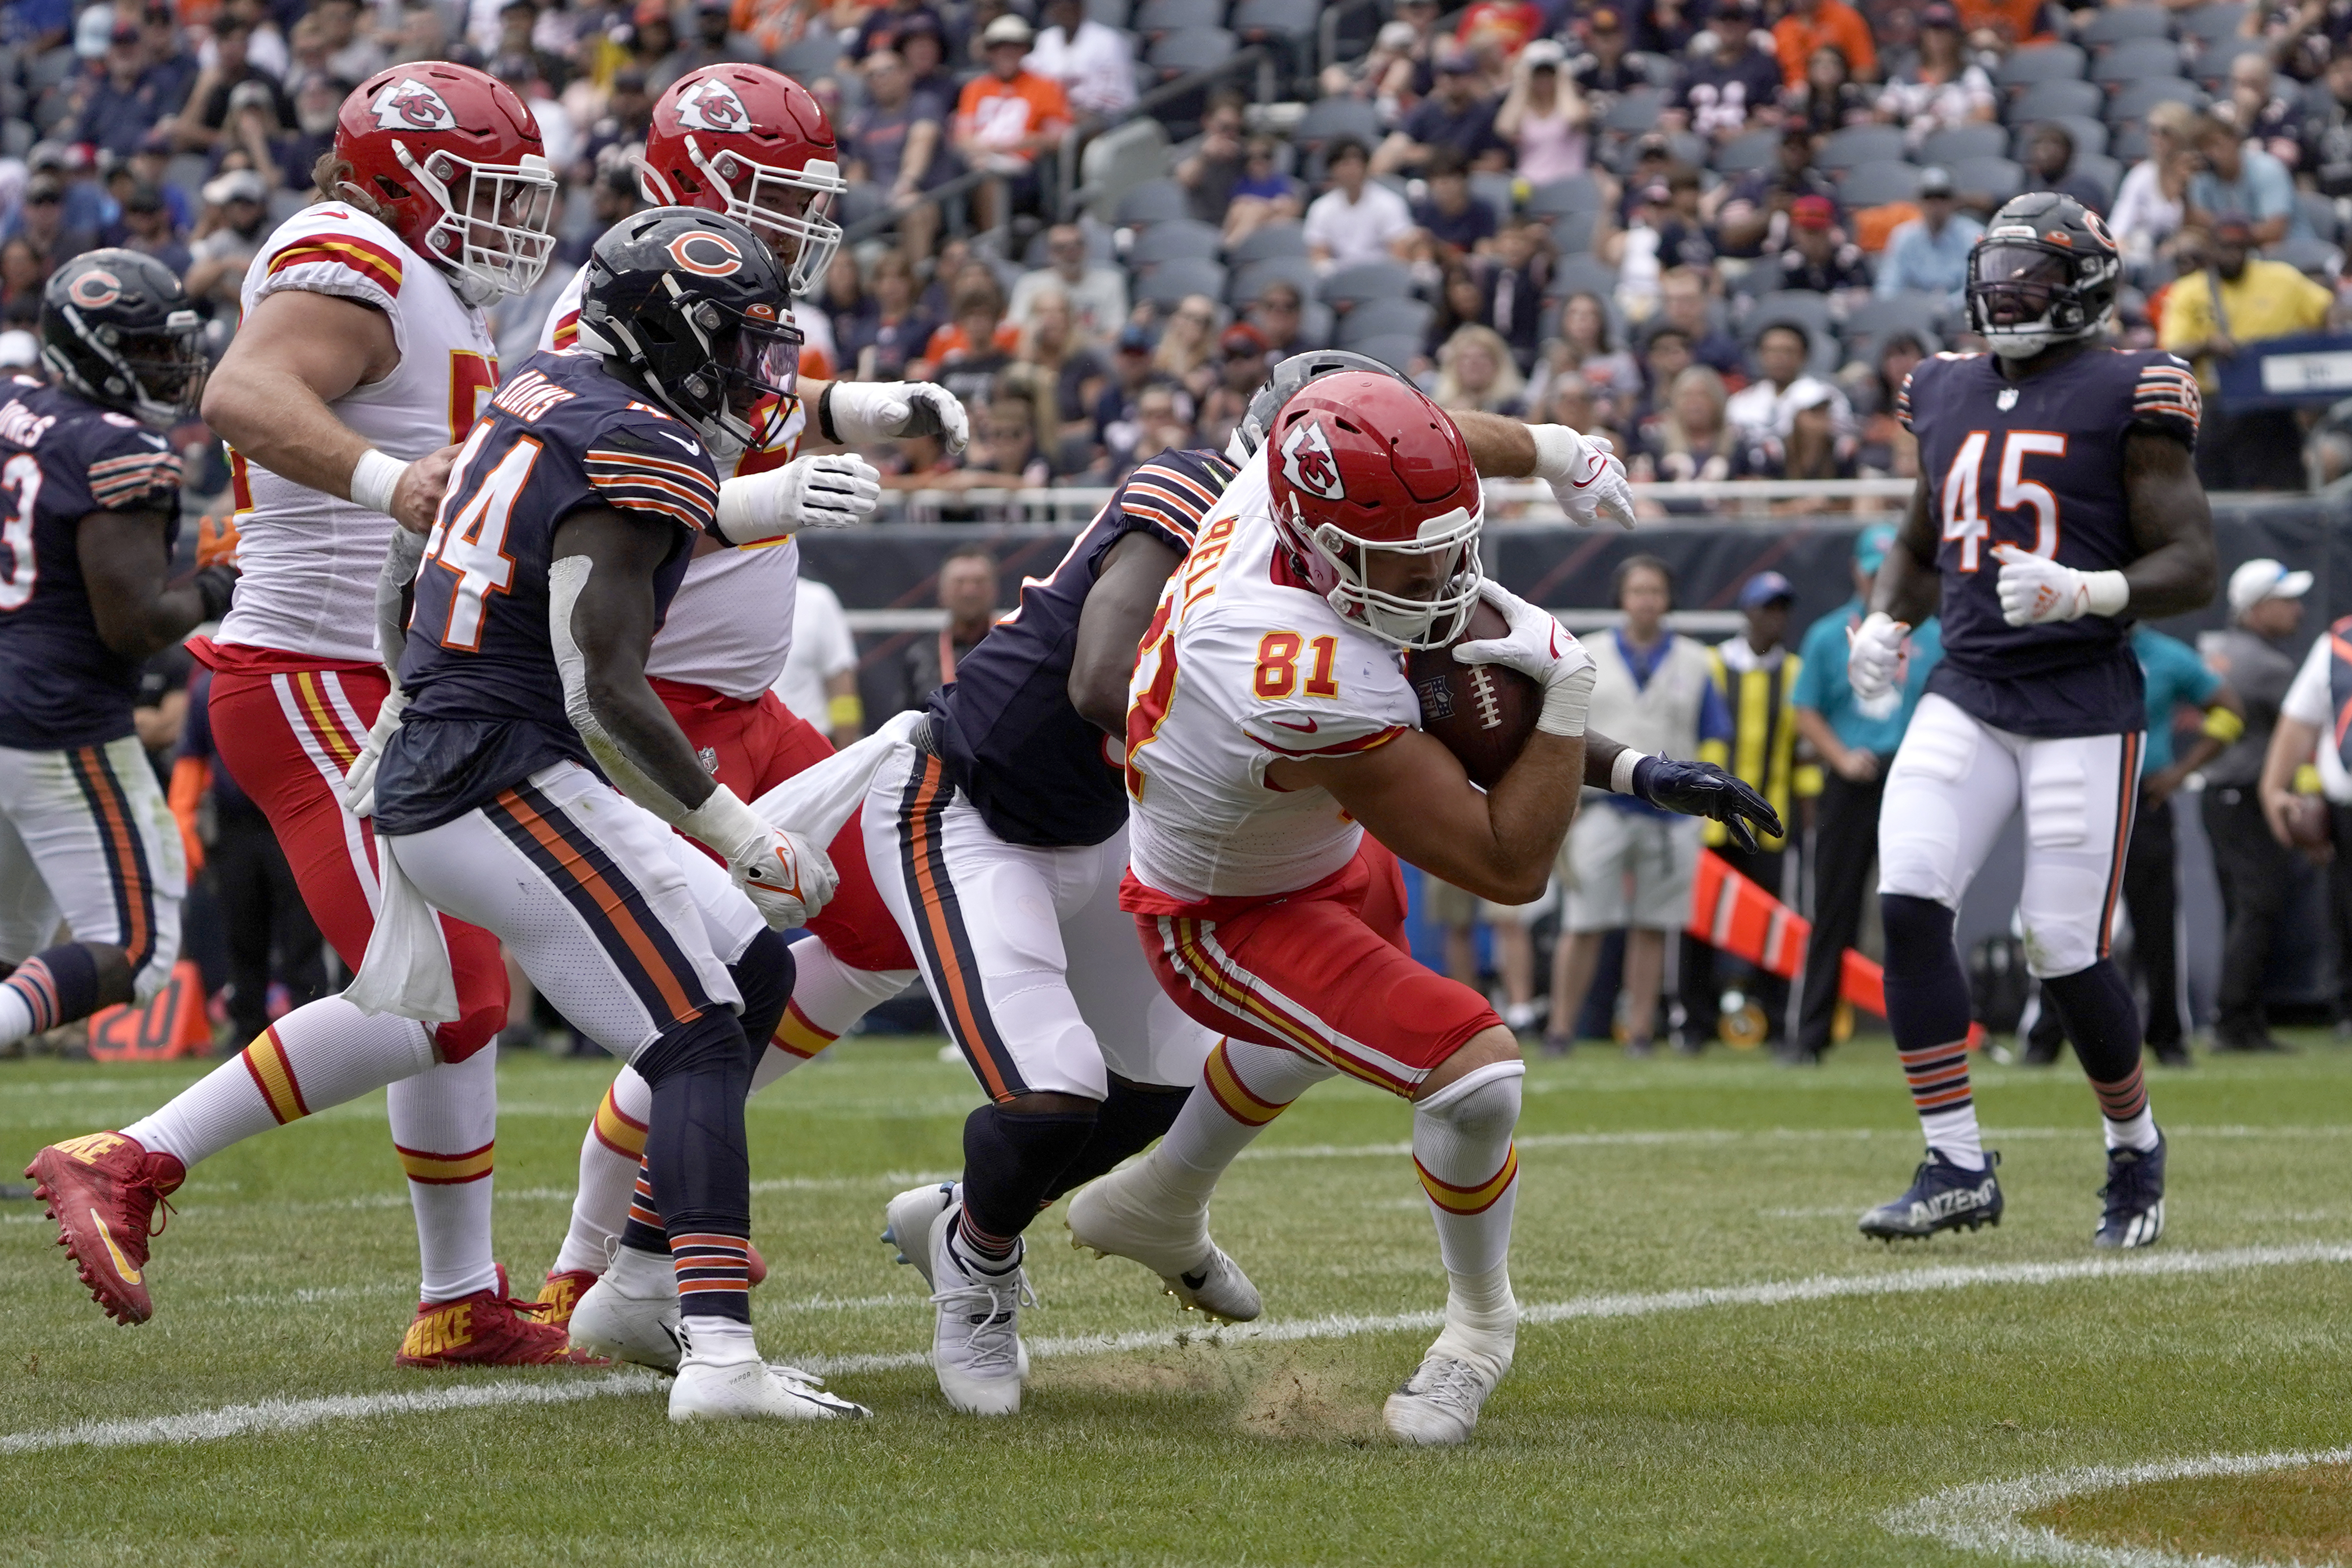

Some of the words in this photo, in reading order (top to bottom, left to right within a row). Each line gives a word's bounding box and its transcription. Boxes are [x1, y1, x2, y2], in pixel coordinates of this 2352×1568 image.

[491, 369, 577, 423] ADAMS
[1941, 430, 2069, 573] 45
[1179, 514, 1239, 627] BELL
[1253, 631, 1338, 700] 81
[1418, 683, 1440, 719] NFL
[704, 758, 716, 769] NFL
[98, 980, 180, 1048] 20
[403, 1303, 472, 1357] NIKE
[729, 1372, 751, 1385] VAPOR
